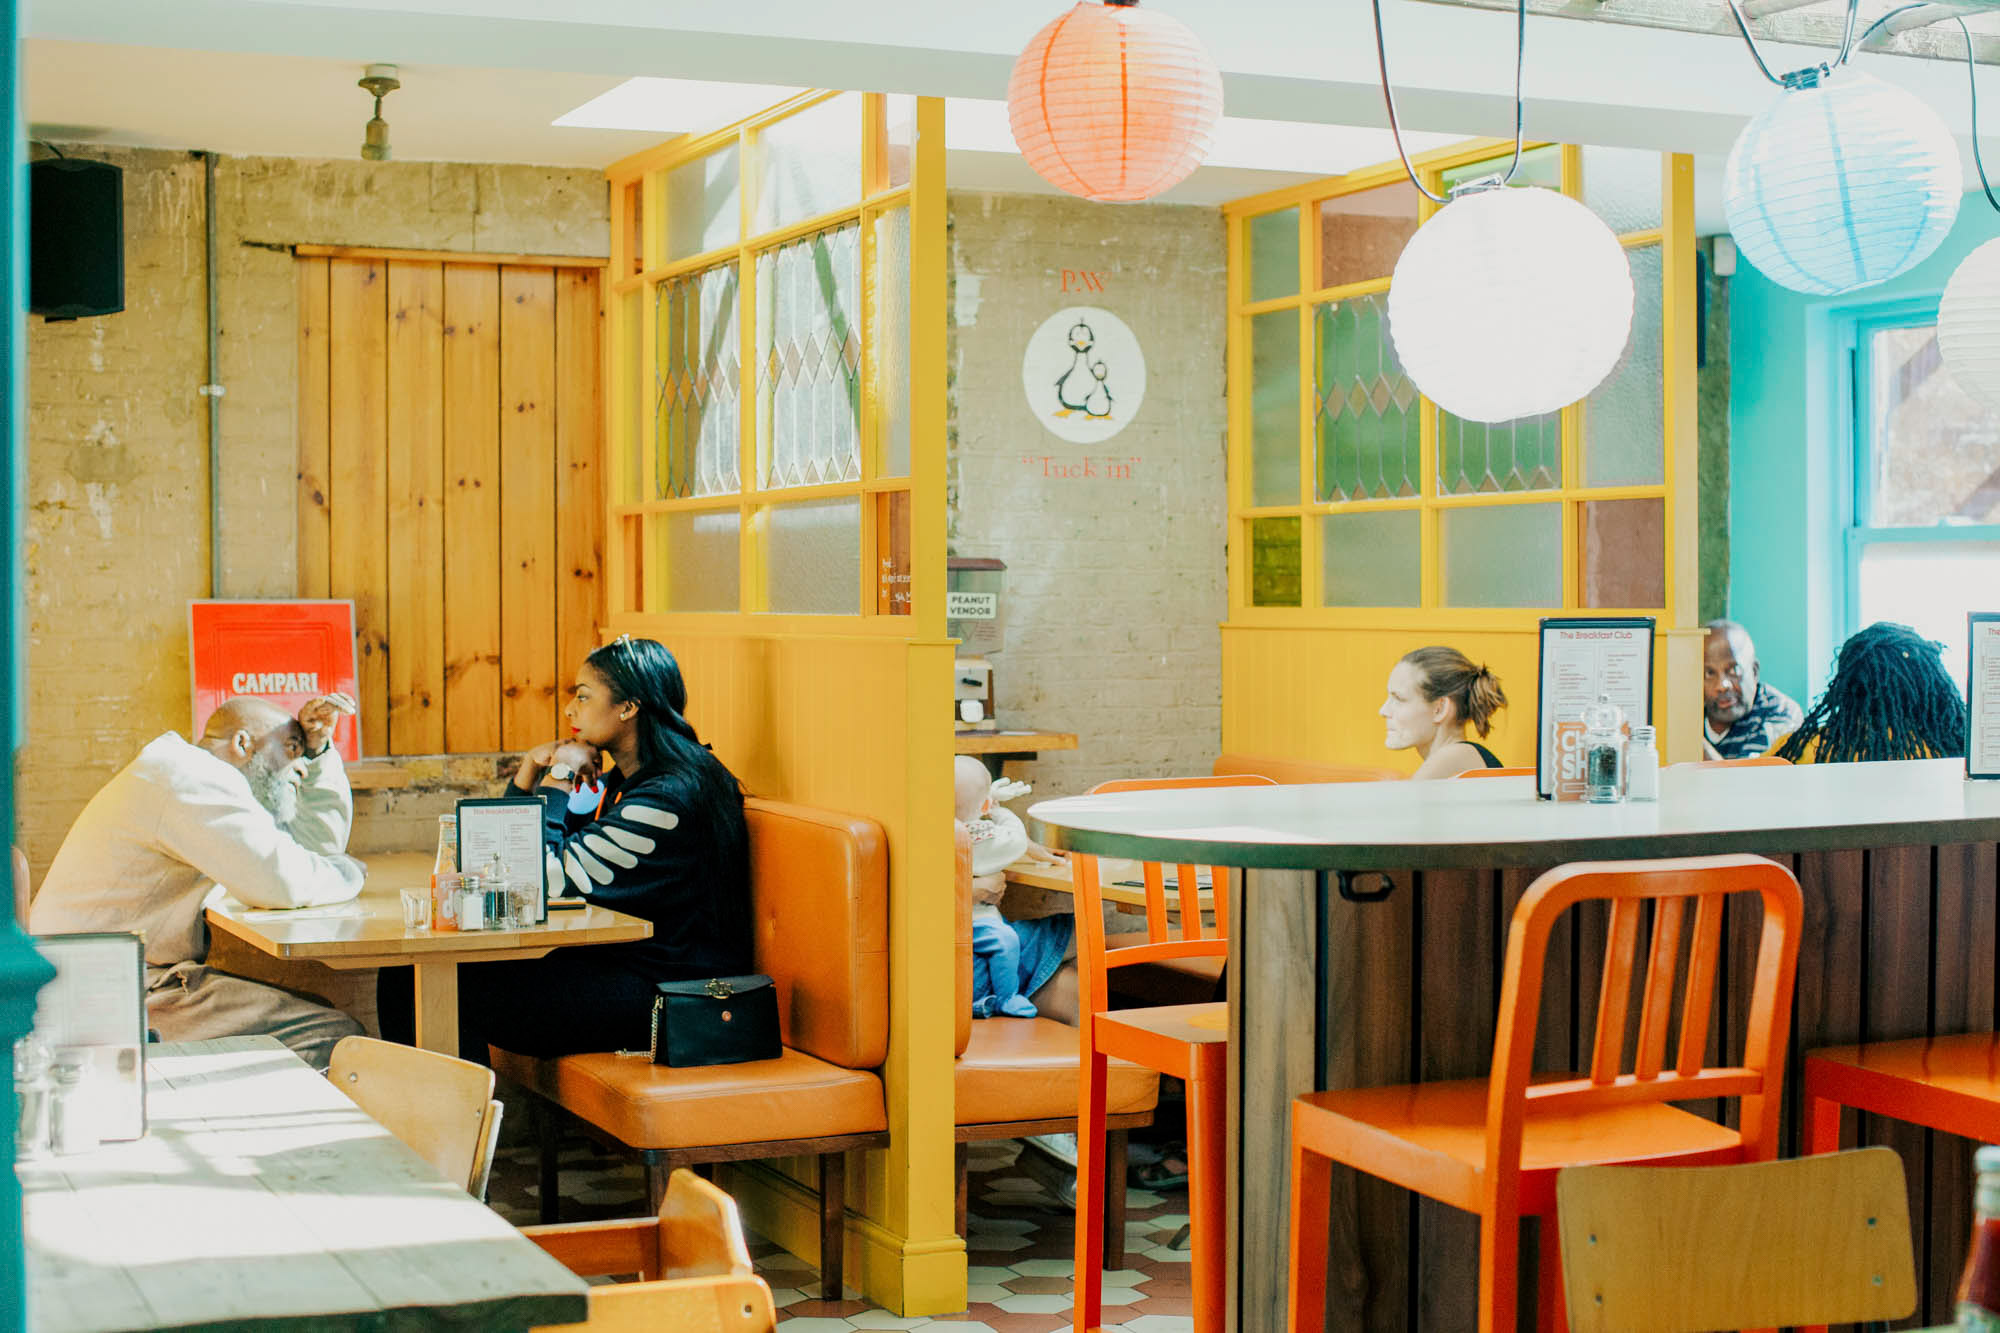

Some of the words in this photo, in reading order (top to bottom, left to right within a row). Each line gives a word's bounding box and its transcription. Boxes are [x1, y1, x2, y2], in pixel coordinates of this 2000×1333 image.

[951, 595, 990, 604] PEANUT
[950, 606, 990, 615] VENDOR
[1560, 631, 1574, 640] The
[1576, 631, 1612, 640] Breakfast
[1615, 630, 1633, 639] Club
[232, 672, 319, 694] CAMPARI
